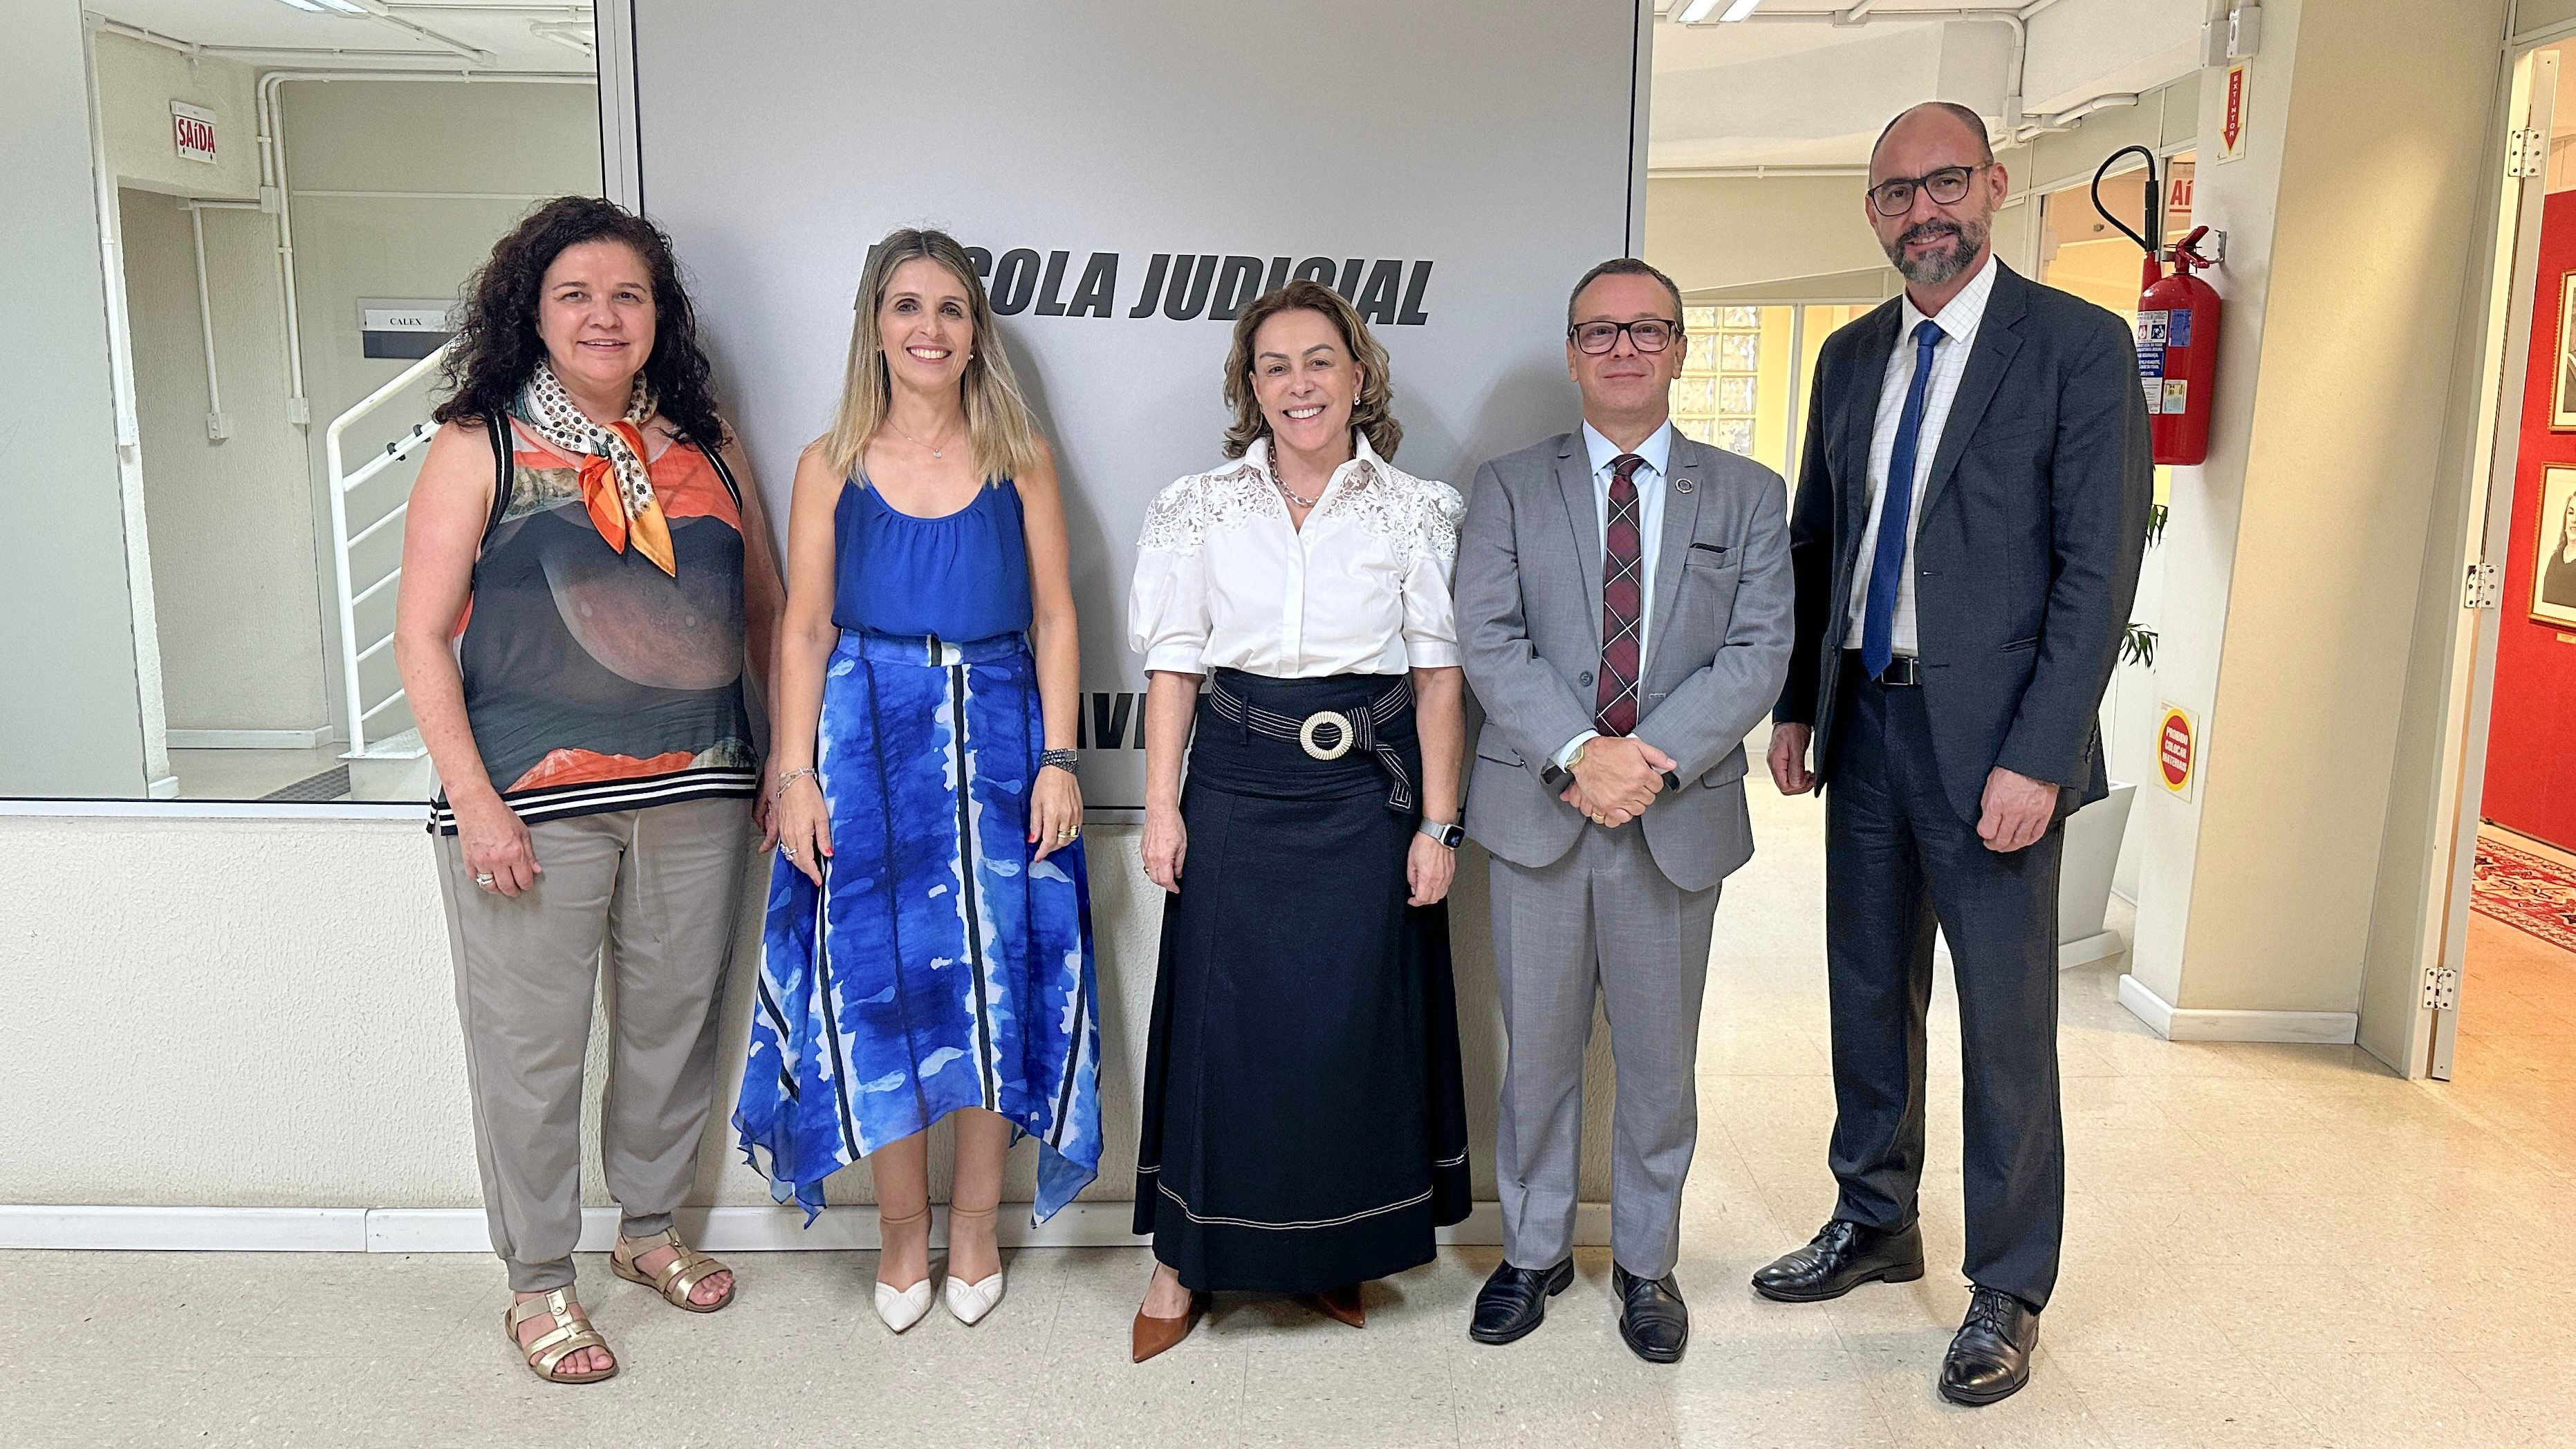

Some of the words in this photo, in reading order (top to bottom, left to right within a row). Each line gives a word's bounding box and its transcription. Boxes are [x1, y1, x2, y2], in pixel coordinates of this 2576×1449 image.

[2229, 75, 2239, 138] EXTINTOR
[853, 245, 1119, 319] OLA
[2166, 726, 2189, 745] PROIBIDO
[2165, 740, 2187, 759] COLOCAR
[2162, 751, 2187, 773] MATERIAIS
